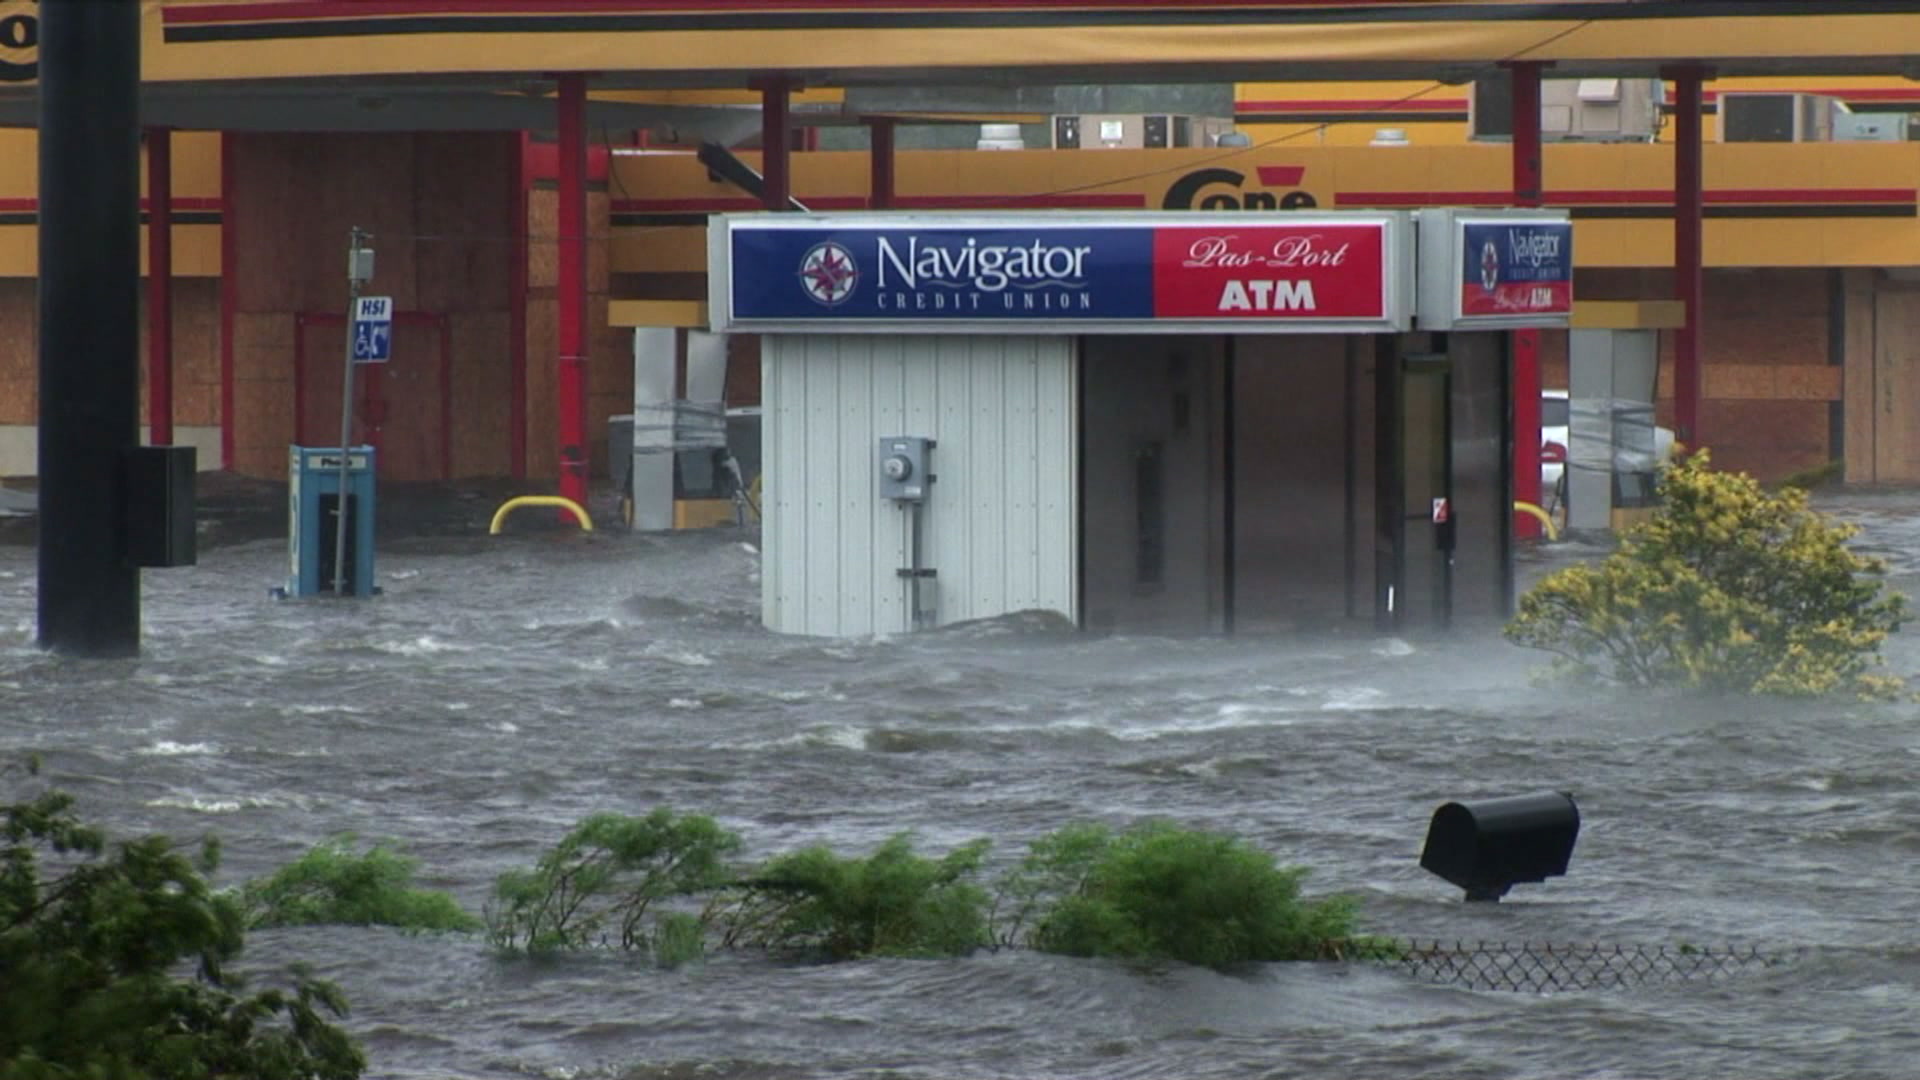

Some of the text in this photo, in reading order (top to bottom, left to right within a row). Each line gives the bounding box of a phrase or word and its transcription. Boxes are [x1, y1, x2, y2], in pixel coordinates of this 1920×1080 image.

[1162, 168, 1317, 210] Cone
[1183, 235, 1349, 267] Pas-Port
[1508, 227, 1560, 267] Navigator
[877, 236, 1091, 291] Navigator
[362, 299, 386, 315] HSI
[877, 292, 1090, 309] CREDIT UNION
[1218, 280, 1316, 310] ATM
[1530, 287, 1552, 308] ATM
